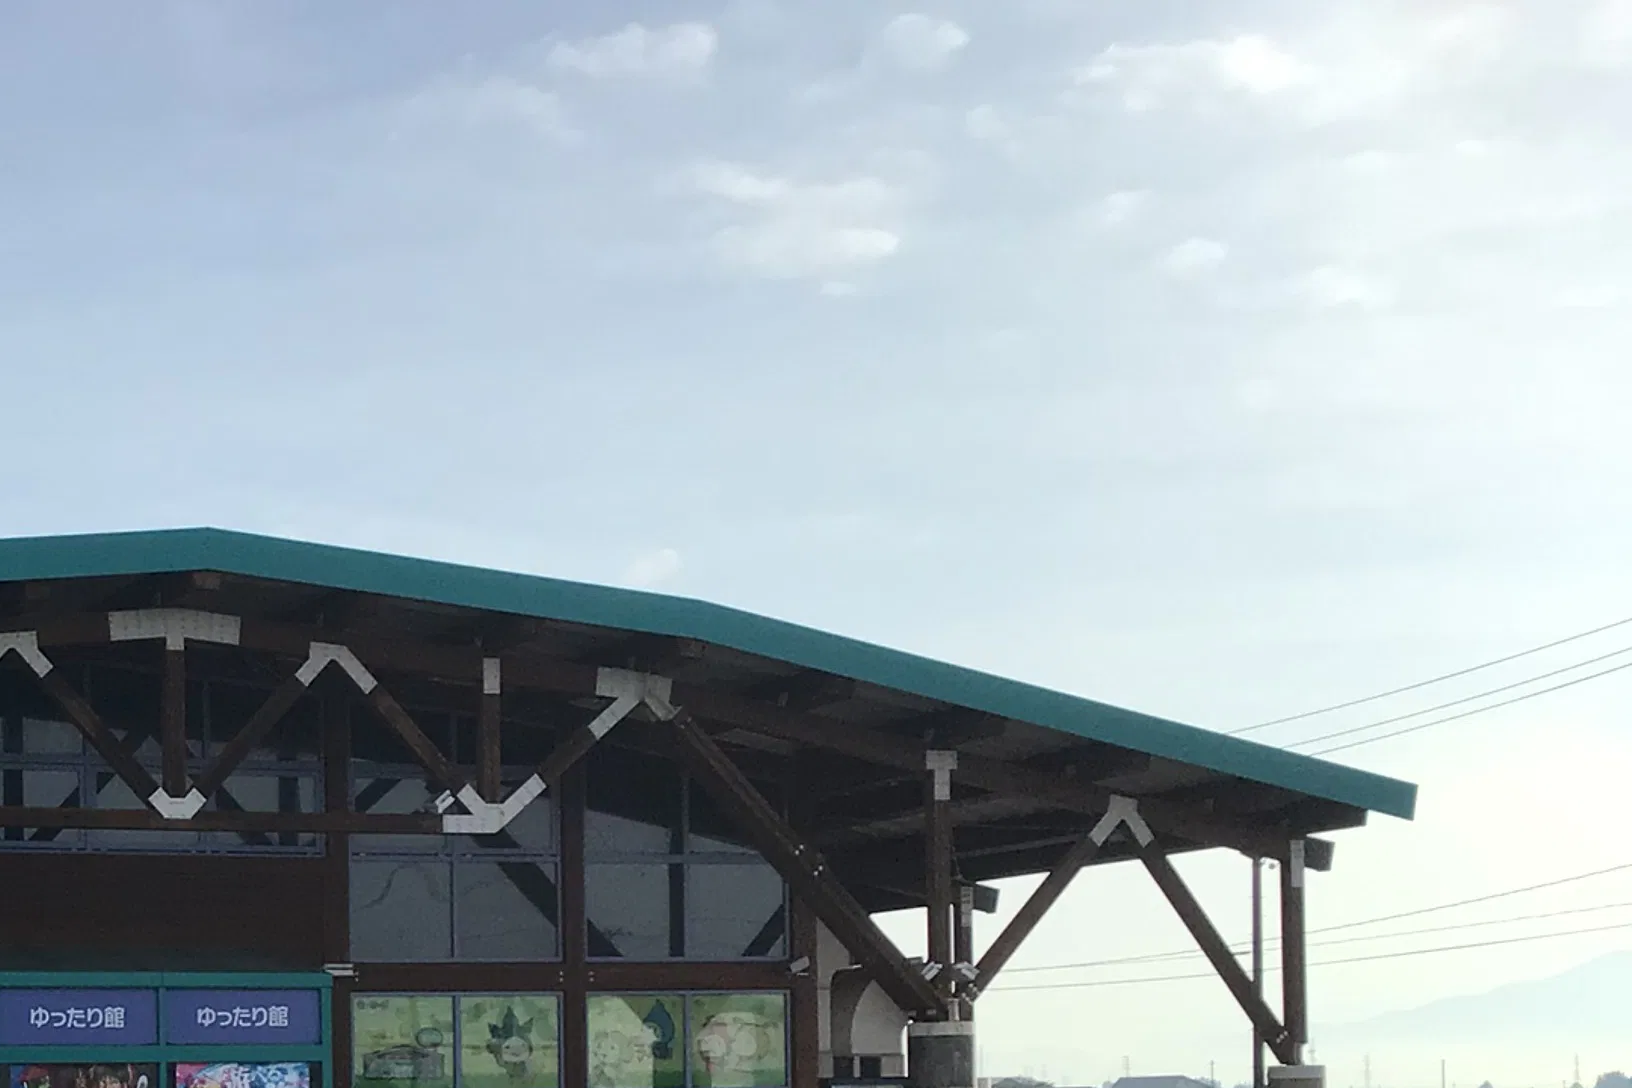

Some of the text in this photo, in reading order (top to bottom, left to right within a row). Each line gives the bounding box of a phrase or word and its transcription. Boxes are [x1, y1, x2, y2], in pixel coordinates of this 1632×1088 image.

[30, 1007, 125, 1029] ゆったり館
[197, 1006, 288, 1027] ゆったり館
